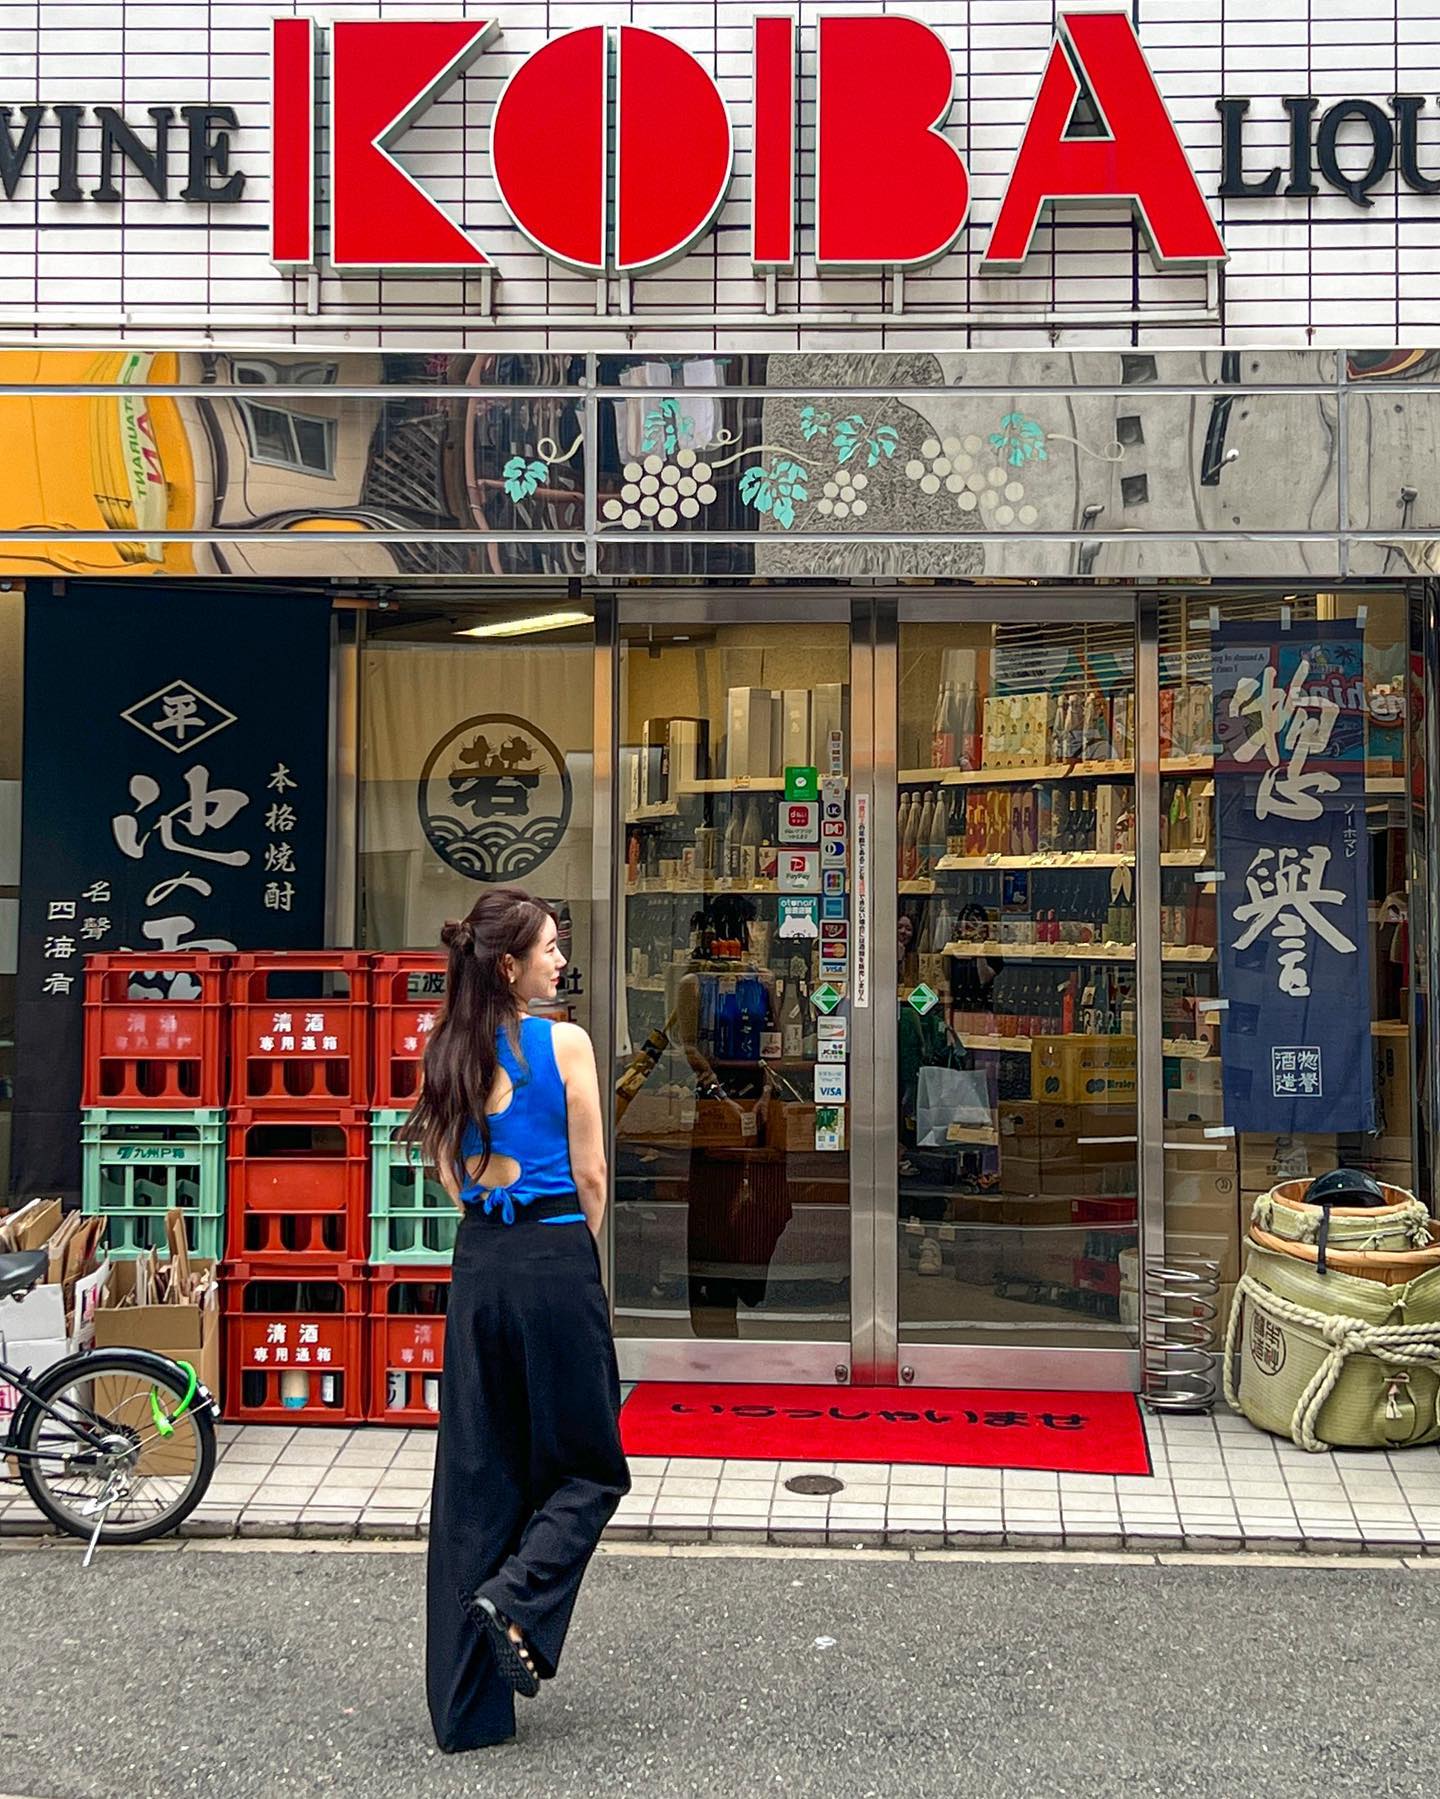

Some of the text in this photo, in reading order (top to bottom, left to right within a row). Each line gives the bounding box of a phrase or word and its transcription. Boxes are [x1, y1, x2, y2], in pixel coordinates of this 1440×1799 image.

[271, 10, 1229, 274] KOBA
[152, 693, 206, 739] 平
[263, 762, 298, 912] 本格焼酎
[272, 1012, 325, 1033] 清酒
[820, 1087, 842, 1096] VISA
[266, 1322, 319, 1344] 清酒
[671, 1402, 1090, 1431] いらっしゃいませ
